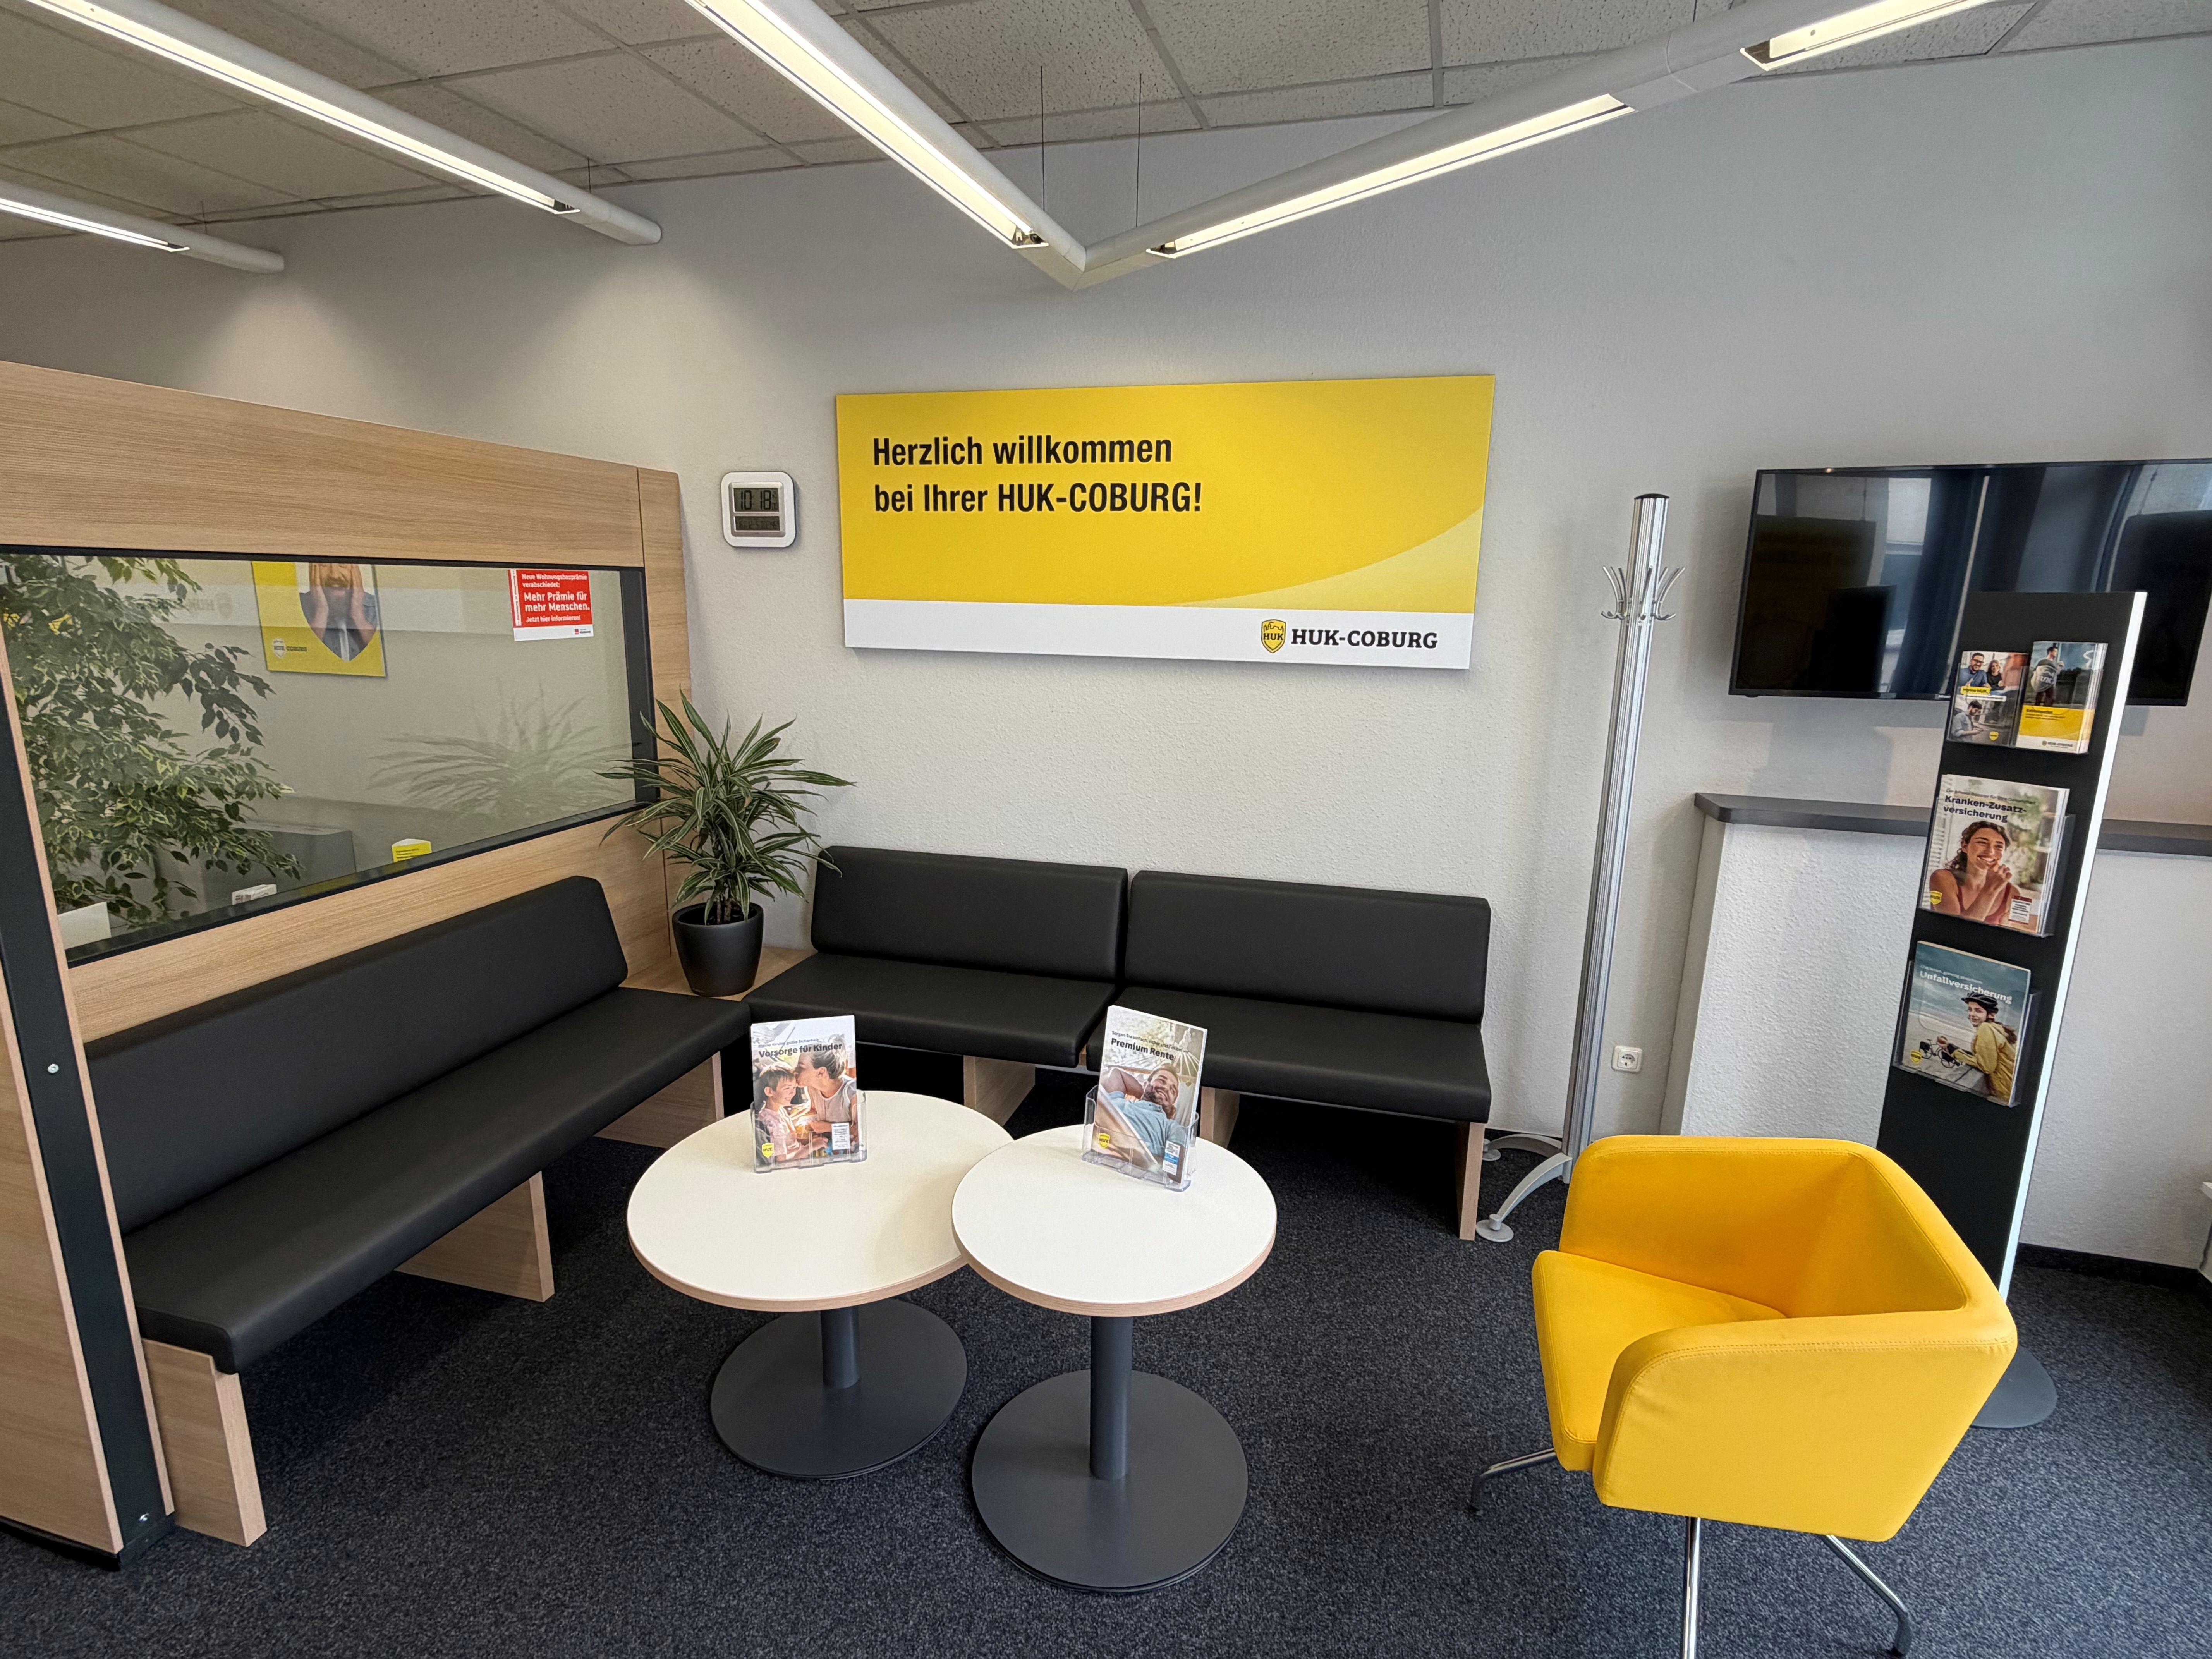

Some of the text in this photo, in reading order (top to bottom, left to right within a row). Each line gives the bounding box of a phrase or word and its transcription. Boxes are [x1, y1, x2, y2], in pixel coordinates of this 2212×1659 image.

[874, 435, 1172, 465] Herzlich willkommen
[875, 482, 1201, 512] bei Ihrer HUK-COBURG!
[524, 591, 587, 601] Mehr Prämie für
[525, 602, 590, 612] mehr Menschen.
[1263, 629, 1438, 649] HUK HUK-COBURG
[1944, 795, 2027, 813] Kranken-Zusatz-
[1943, 806, 2008, 823] versicherung
[1920, 970, 2013, 1005] Unfallversicherung
[758, 1042, 843, 1058] Vorsorge für Kinder
[1111, 1038, 1174, 1060] Premium Rente
